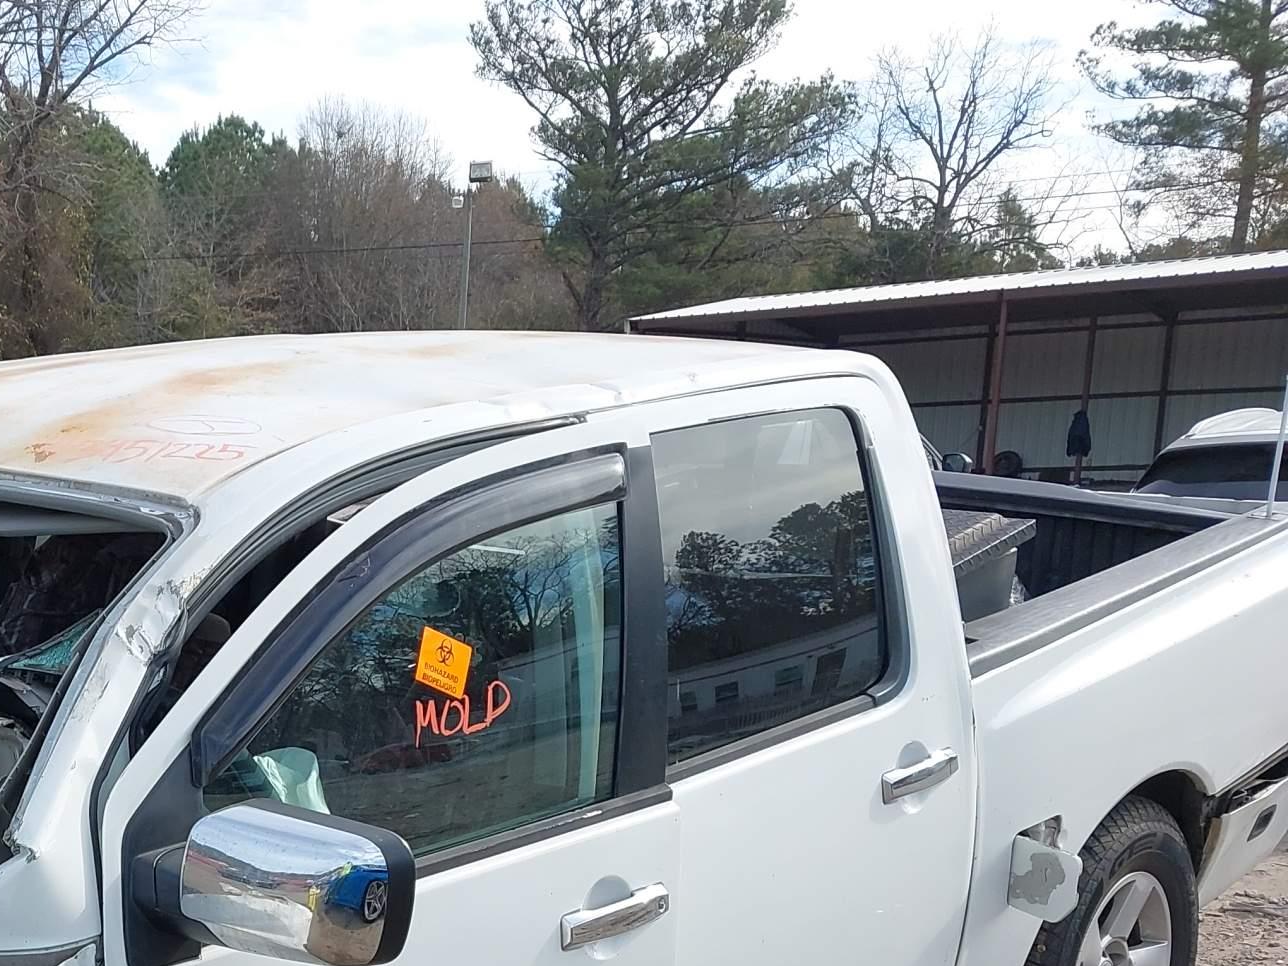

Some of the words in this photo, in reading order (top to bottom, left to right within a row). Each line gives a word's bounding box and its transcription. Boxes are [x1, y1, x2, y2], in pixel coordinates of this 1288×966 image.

[422, 672, 457, 694] BIOPELIGRO
[424, 661, 459, 684] BIOHAZARD
[415, 680, 511, 748] MOLD
